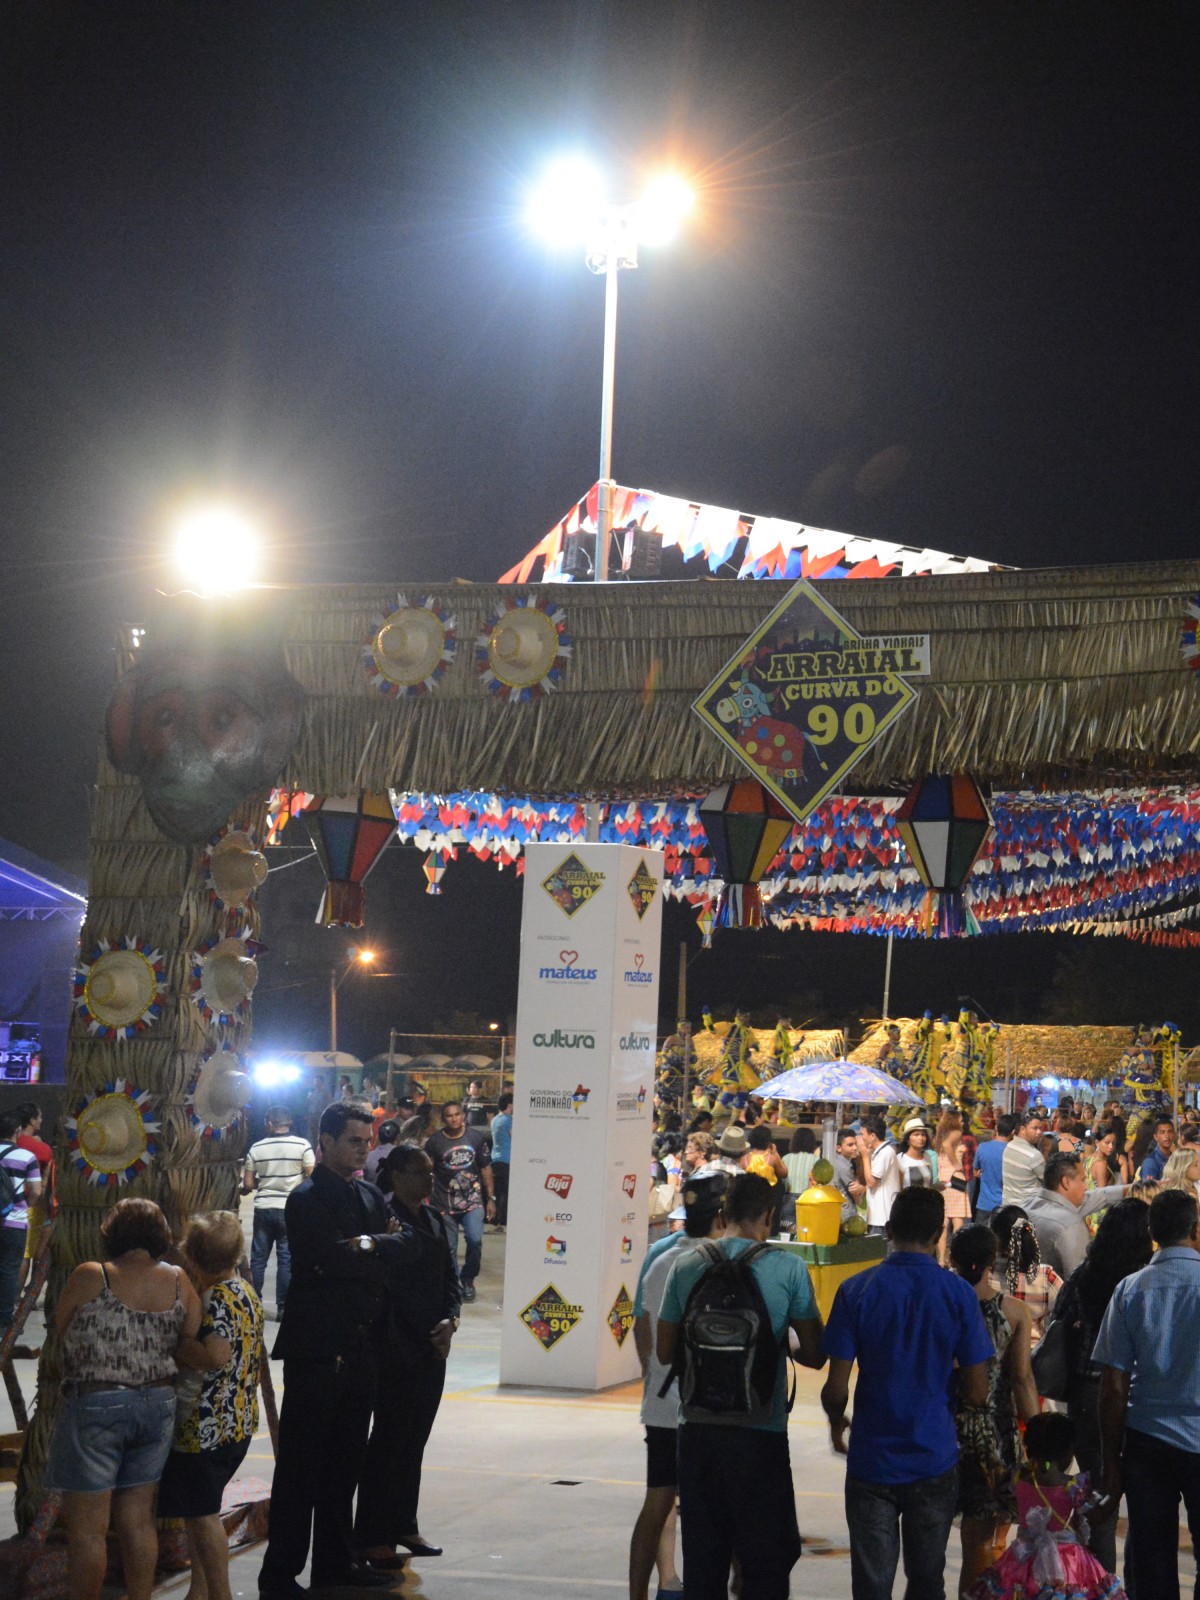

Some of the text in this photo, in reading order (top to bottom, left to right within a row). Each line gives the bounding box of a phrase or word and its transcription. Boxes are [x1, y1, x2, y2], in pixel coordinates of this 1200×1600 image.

[768, 649, 922, 681] ARRAIAL
[785, 680, 899, 700] CURVA DO
[807, 702, 876, 745] 90
[572, 886, 593, 899] 90
[539, 965, 597, 980] mateus
[624, 969, 653, 983] mateus
[533, 1029, 595, 1049] cultura
[619, 1032, 650, 1050] cultura
[530, 1096, 572, 1109] MARANHÃO
[547, 1176, 569, 1192] Biju
[555, 1213, 573, 1221] ECO
[540, 1303, 584, 1313] ARRAIAL
[550, 1319, 570, 1332] 90
[622, 1316, 633, 1328] 90
